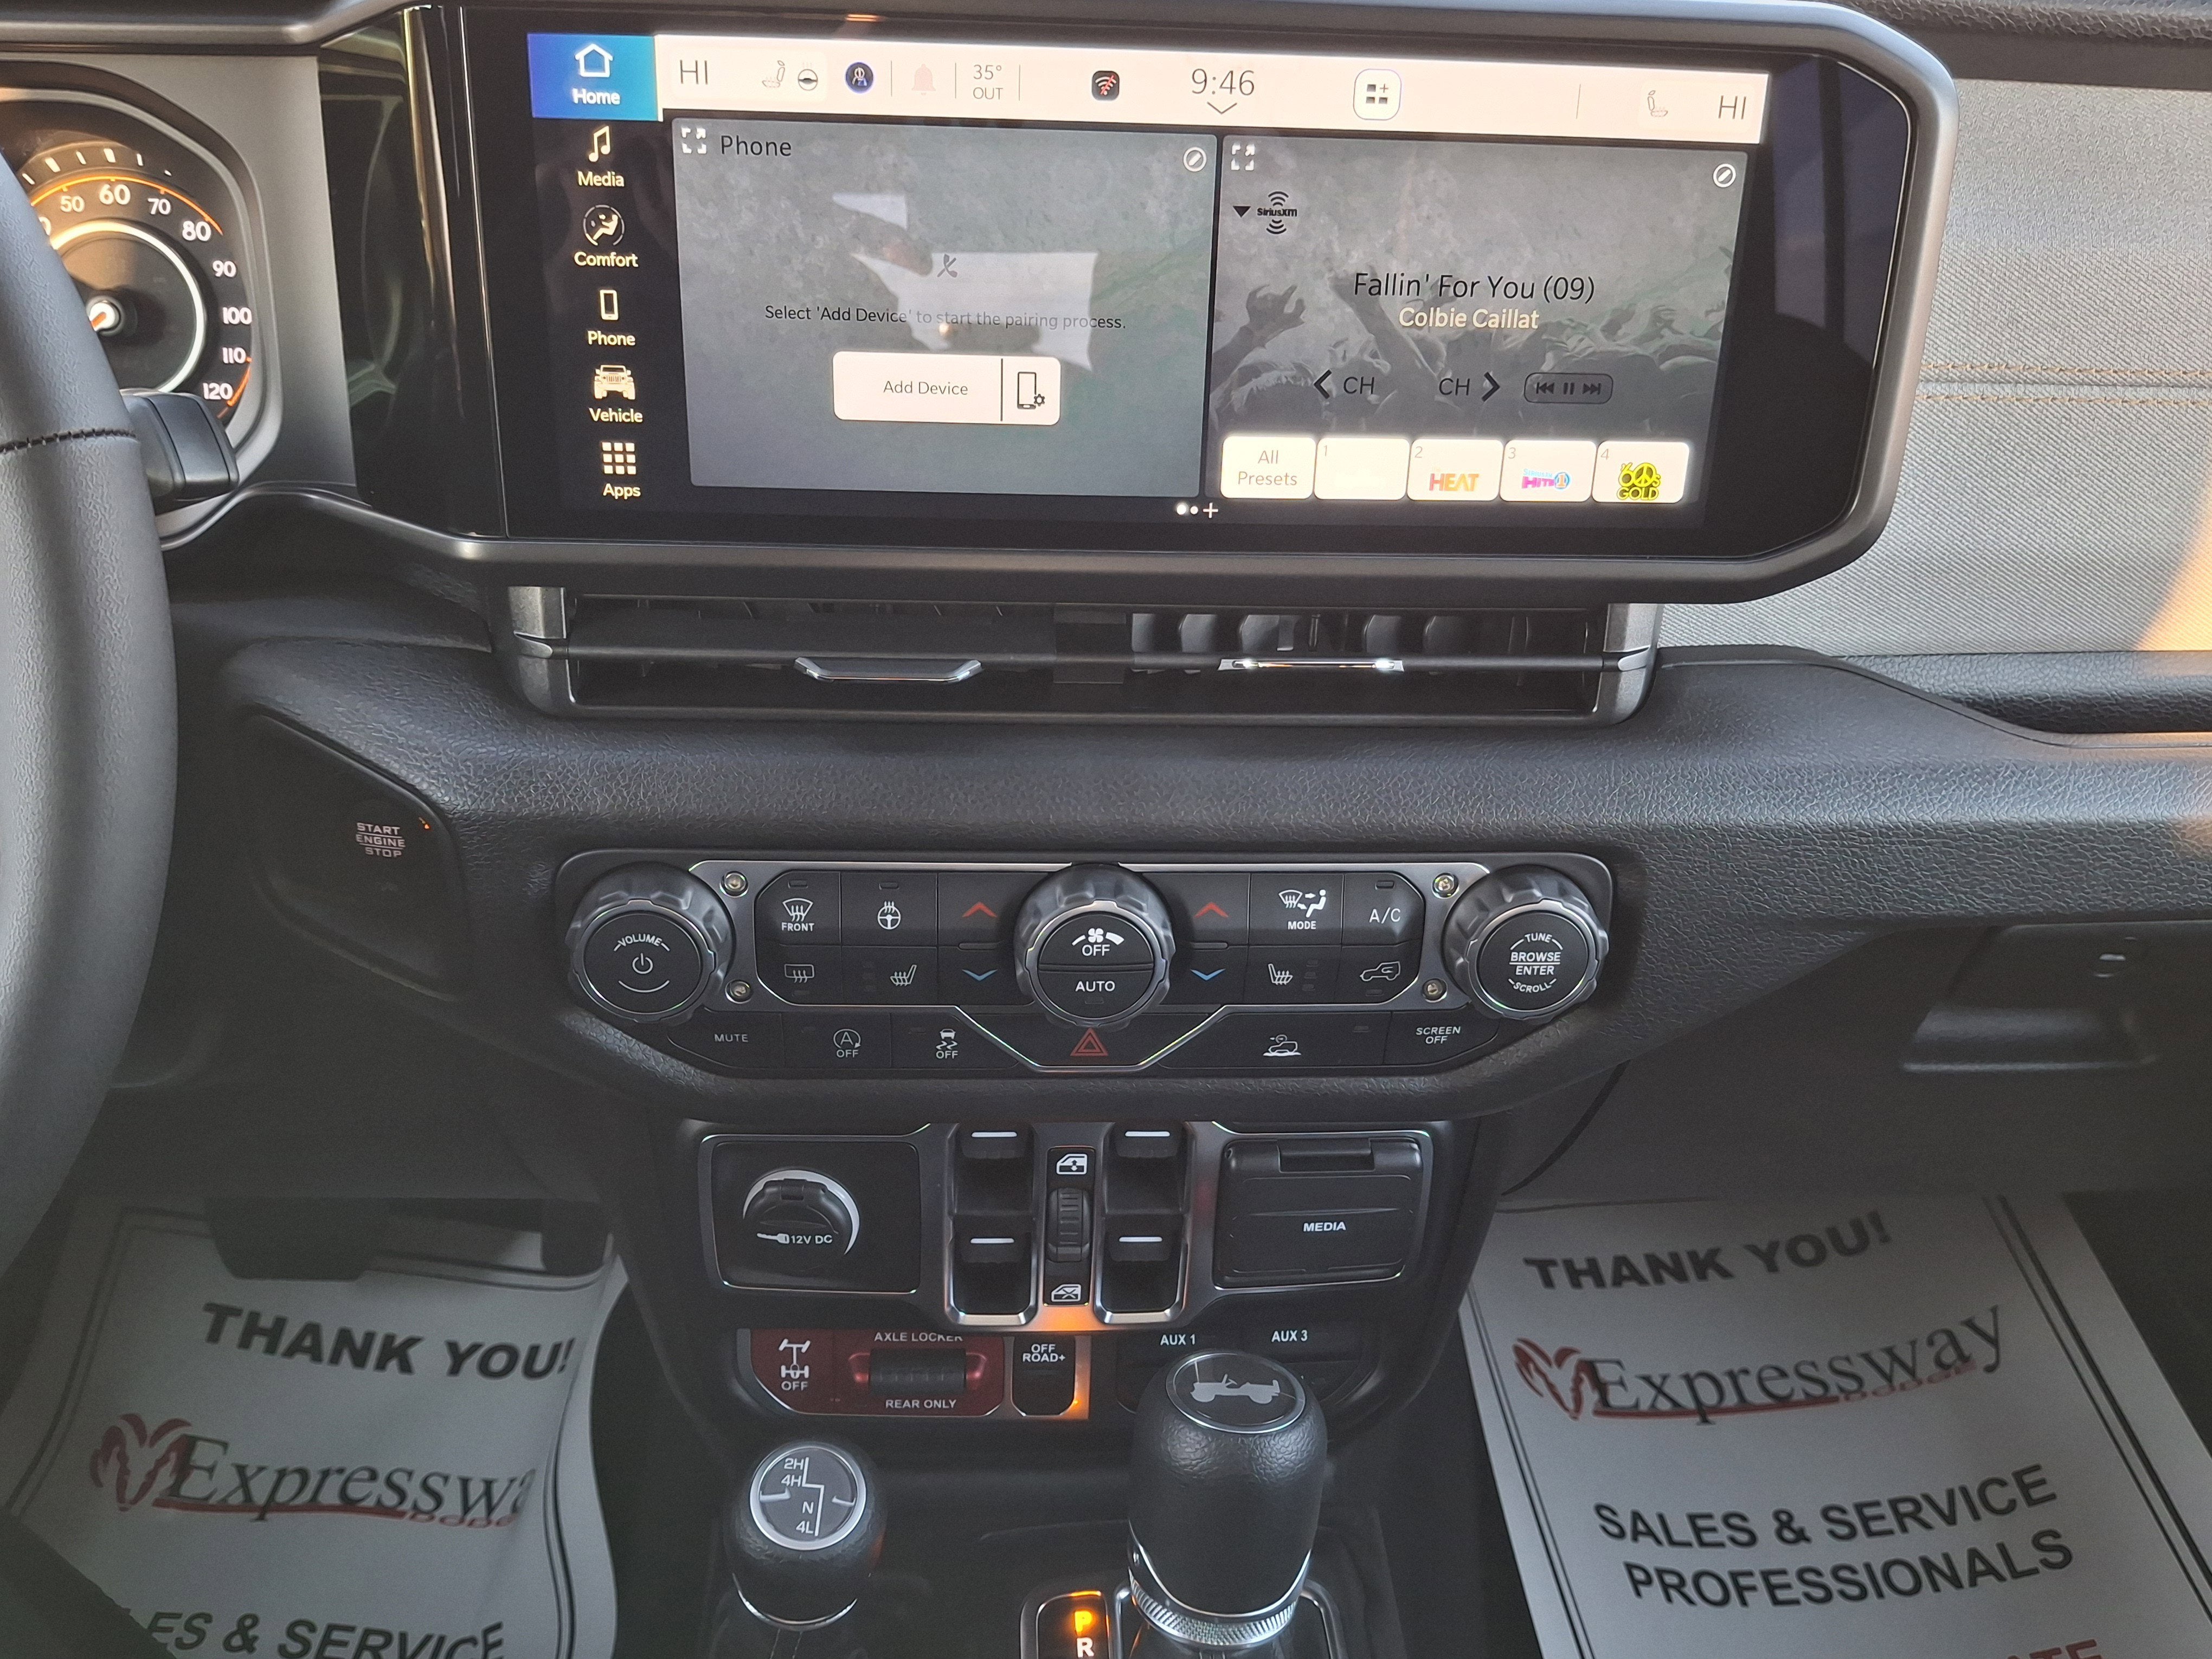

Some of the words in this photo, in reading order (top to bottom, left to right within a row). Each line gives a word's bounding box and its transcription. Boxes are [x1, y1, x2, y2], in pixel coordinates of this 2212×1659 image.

[679, 60, 709, 85] HI
[973, 65, 1002, 80] 35°
[1191, 68, 1255, 96] 9:46
[573, 88, 620, 105] Home
[973, 87, 1003, 100] OUT
[1718, 95, 1746, 119] HI
[721, 136, 792, 157] Phone
[577, 171, 625, 187] Media
[99, 185, 131, 204] 60
[60, 196, 85, 213] 50
[147, 198, 171, 215] 70
[182, 221, 211, 241] 80
[574, 252, 638, 267] Comfort
[213, 261, 236, 277] 90
[1354, 273, 1430, 296] Fallin'
[1438, 275, 1480, 298] For
[1488, 275, 1535, 299] You
[1544, 276, 1594, 304] (09)
[223, 307, 252, 324] 100
[765, 305, 812, 320] Select
[816, 306, 851, 322] 'Add
[856, 307, 912, 323] Device'
[917, 311, 932, 324] to
[936, 311, 972, 325] start
[975, 312, 1000, 326] the
[1005, 314, 1058, 330] pairing
[1063, 316, 1126, 330] process.
[1399, 307, 1467, 327] Colbie
[1472, 309, 1539, 329] Caillat
[588, 330, 636, 346] Phone
[222, 348, 246, 364] 110
[203, 383, 233, 399] 120
[883, 381, 913, 394] Add
[918, 382, 968, 396] Device
[1343, 376, 1374, 394] CH
[1439, 378, 1470, 396] CH
[589, 407, 643, 423] Vehicle
[1258, 450, 1278, 464] All
[1323, 445, 1328, 456] 1
[1414, 446, 1423, 458] 2
[1508, 447, 1516, 459] 3
[1600, 448, 1610, 460] 4
[1238, 471, 1297, 486] Presets
[1429, 473, 1479, 491] HEAT
[602, 483, 641, 499] Apps
[1617, 487, 1659, 500] GOLD
[357, 822, 400, 835] START
[356, 834, 406, 847] ENGINE
[365, 847, 401, 857] STOP
[1369, 907, 1401, 923] A/C
[781, 922, 814, 931] FRONT
[1288, 921, 1316, 930] MODE
[618, 933, 662, 948] VOLUME
[1525, 933, 1553, 943] TUNE
[1082, 944, 1110, 956] OFF
[1510, 952, 1561, 962] BROWSE
[1515, 966, 1554, 975] ENTER
[1075, 981, 1115, 992] AUTO
[1513, 982, 1552, 993] SCROLL
[714, 1034, 749, 1043] MUTE
[1416, 1026, 1461, 1036] SCREEN
[1425, 1036, 1448, 1044] OFF
[836, 1049, 859, 1058] OFF
[936, 1051, 958, 1059] OFF
[1303, 1221, 1346, 1232] MEDIA
[791, 1235, 812, 1244] 12V
[815, 1235, 832, 1244] DC
[1523, 1248, 1733, 1289] THANK
[1745, 1211, 1891, 1273] YOU!
[202, 1303, 425, 1375] THANK
[444, 1337, 576, 1379] YOU!
[874, 1332, 908, 1341] AXLE
[1160, 1334, 1186, 1346] AUX
[1191, 1334, 1196, 1345] 1
[1271, 1330, 1298, 1342] AUX
[1301, 1330, 1308, 1341] 3
[1031, 1344, 1055, 1353] OFF
[1023, 1353, 1066, 1362] ROAD+
[1580, 1304, 2003, 1426] Expressway
[781, 1381, 808, 1391] OFF
[885, 1399, 920, 1409] REAR
[923, 1399, 957, 1409] ONLY
[784, 1457, 803, 1470] 2H
[781, 1474, 801, 1487] 4H
[802, 1501, 814, 1514] N
[1593, 1502, 1758, 1548] SALES
[1771, 1508, 1812, 1545] &
[1819, 1463, 2058, 1541] SERVICE
[796, 1521, 813, 1534] 4L
[1623, 1529, 2073, 1607] PROFESSIONALS
[1075, 1611, 1092, 1635] P
[221, 1612, 260, 1653] &
[276, 1621, 503, 1659] SERVICE
[1077, 1637, 1094, 1657] R
